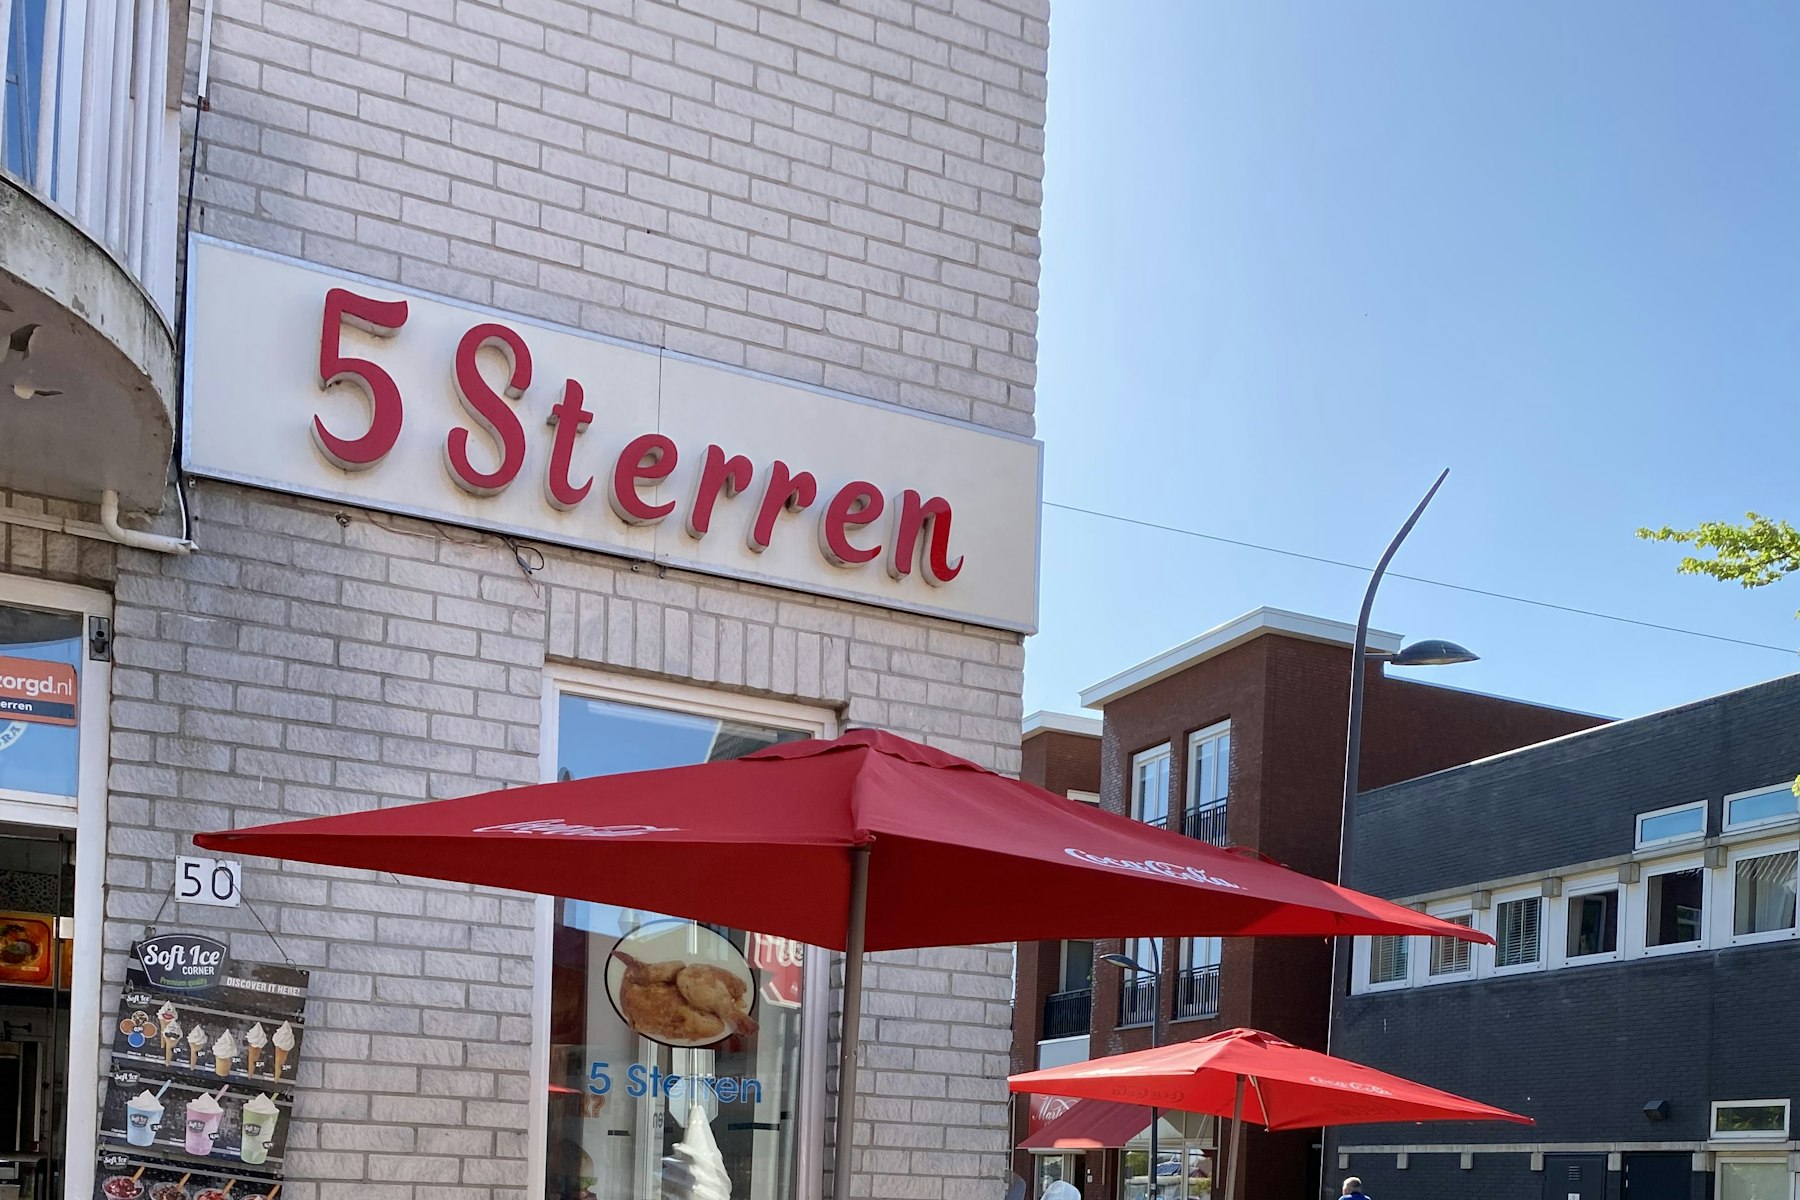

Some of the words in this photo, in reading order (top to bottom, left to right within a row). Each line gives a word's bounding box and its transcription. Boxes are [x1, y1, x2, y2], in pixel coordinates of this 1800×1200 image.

[310, 287, 410, 471] 5
[443, 322, 965, 587] Sterren
[0, 675, 72, 697] orgd.nl
[181, 863, 233, 900] 50
[144, 944, 186, 972] Soft
[189, 944, 220, 966] Ice
[160, 976, 188, 987] Premium
[188, 978, 208, 988] quality
[182, 966, 214, 976] CORNER
[226, 977, 267, 992] DISCOVER
[267, 983, 276, 993] IT
[277, 985, 301, 997] HERE!
[126, 993, 140, 1004] Soft
[140, 994, 150, 1002] Ice
[588, 1062, 612, 1095] 5
[626, 1063, 762, 1103] Sterren
